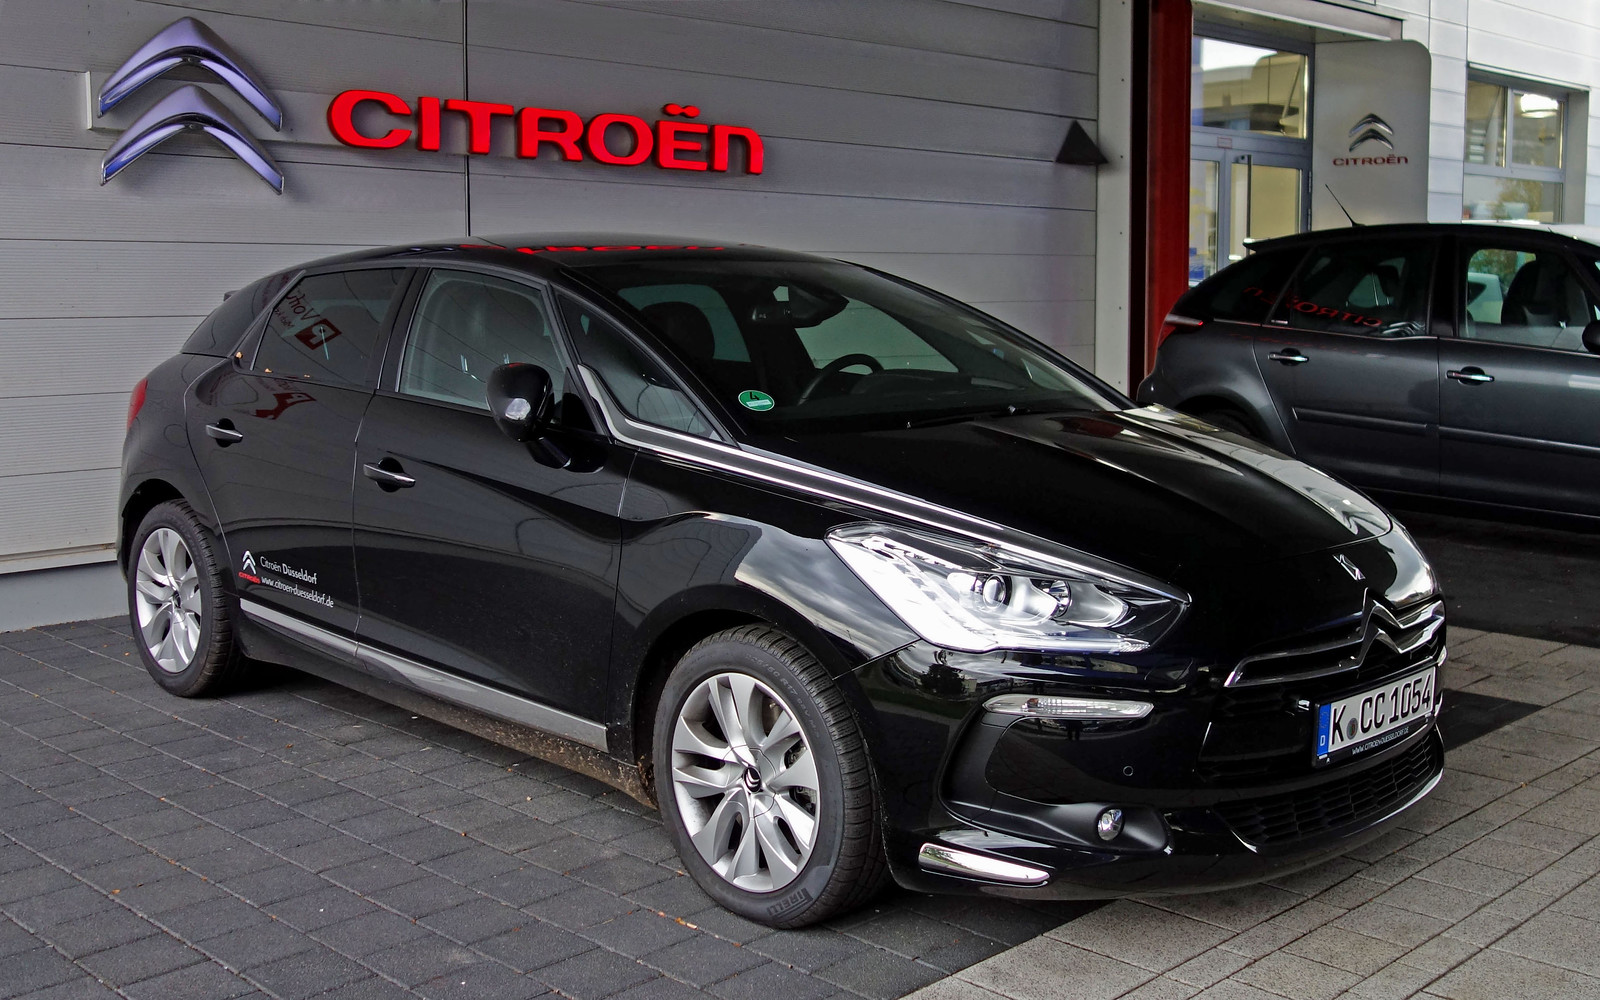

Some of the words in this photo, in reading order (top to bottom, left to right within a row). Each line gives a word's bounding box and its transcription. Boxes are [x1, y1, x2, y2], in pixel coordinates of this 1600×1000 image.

[327, 89, 764, 175] CITROËN
[1332, 153, 1409, 167] CITROËN
[260, 556, 282, 572] Citroën
[282, 563, 318, 584] Düsseldorf
[261, 577, 334, 608] www.citroen-duesseldorf.de
[1331, 704, 1346, 745] K
[1388, 673, 1431, 724] 1054
[1320, 735, 1326, 746] D
[766, 887, 814, 919] PIRELLI
